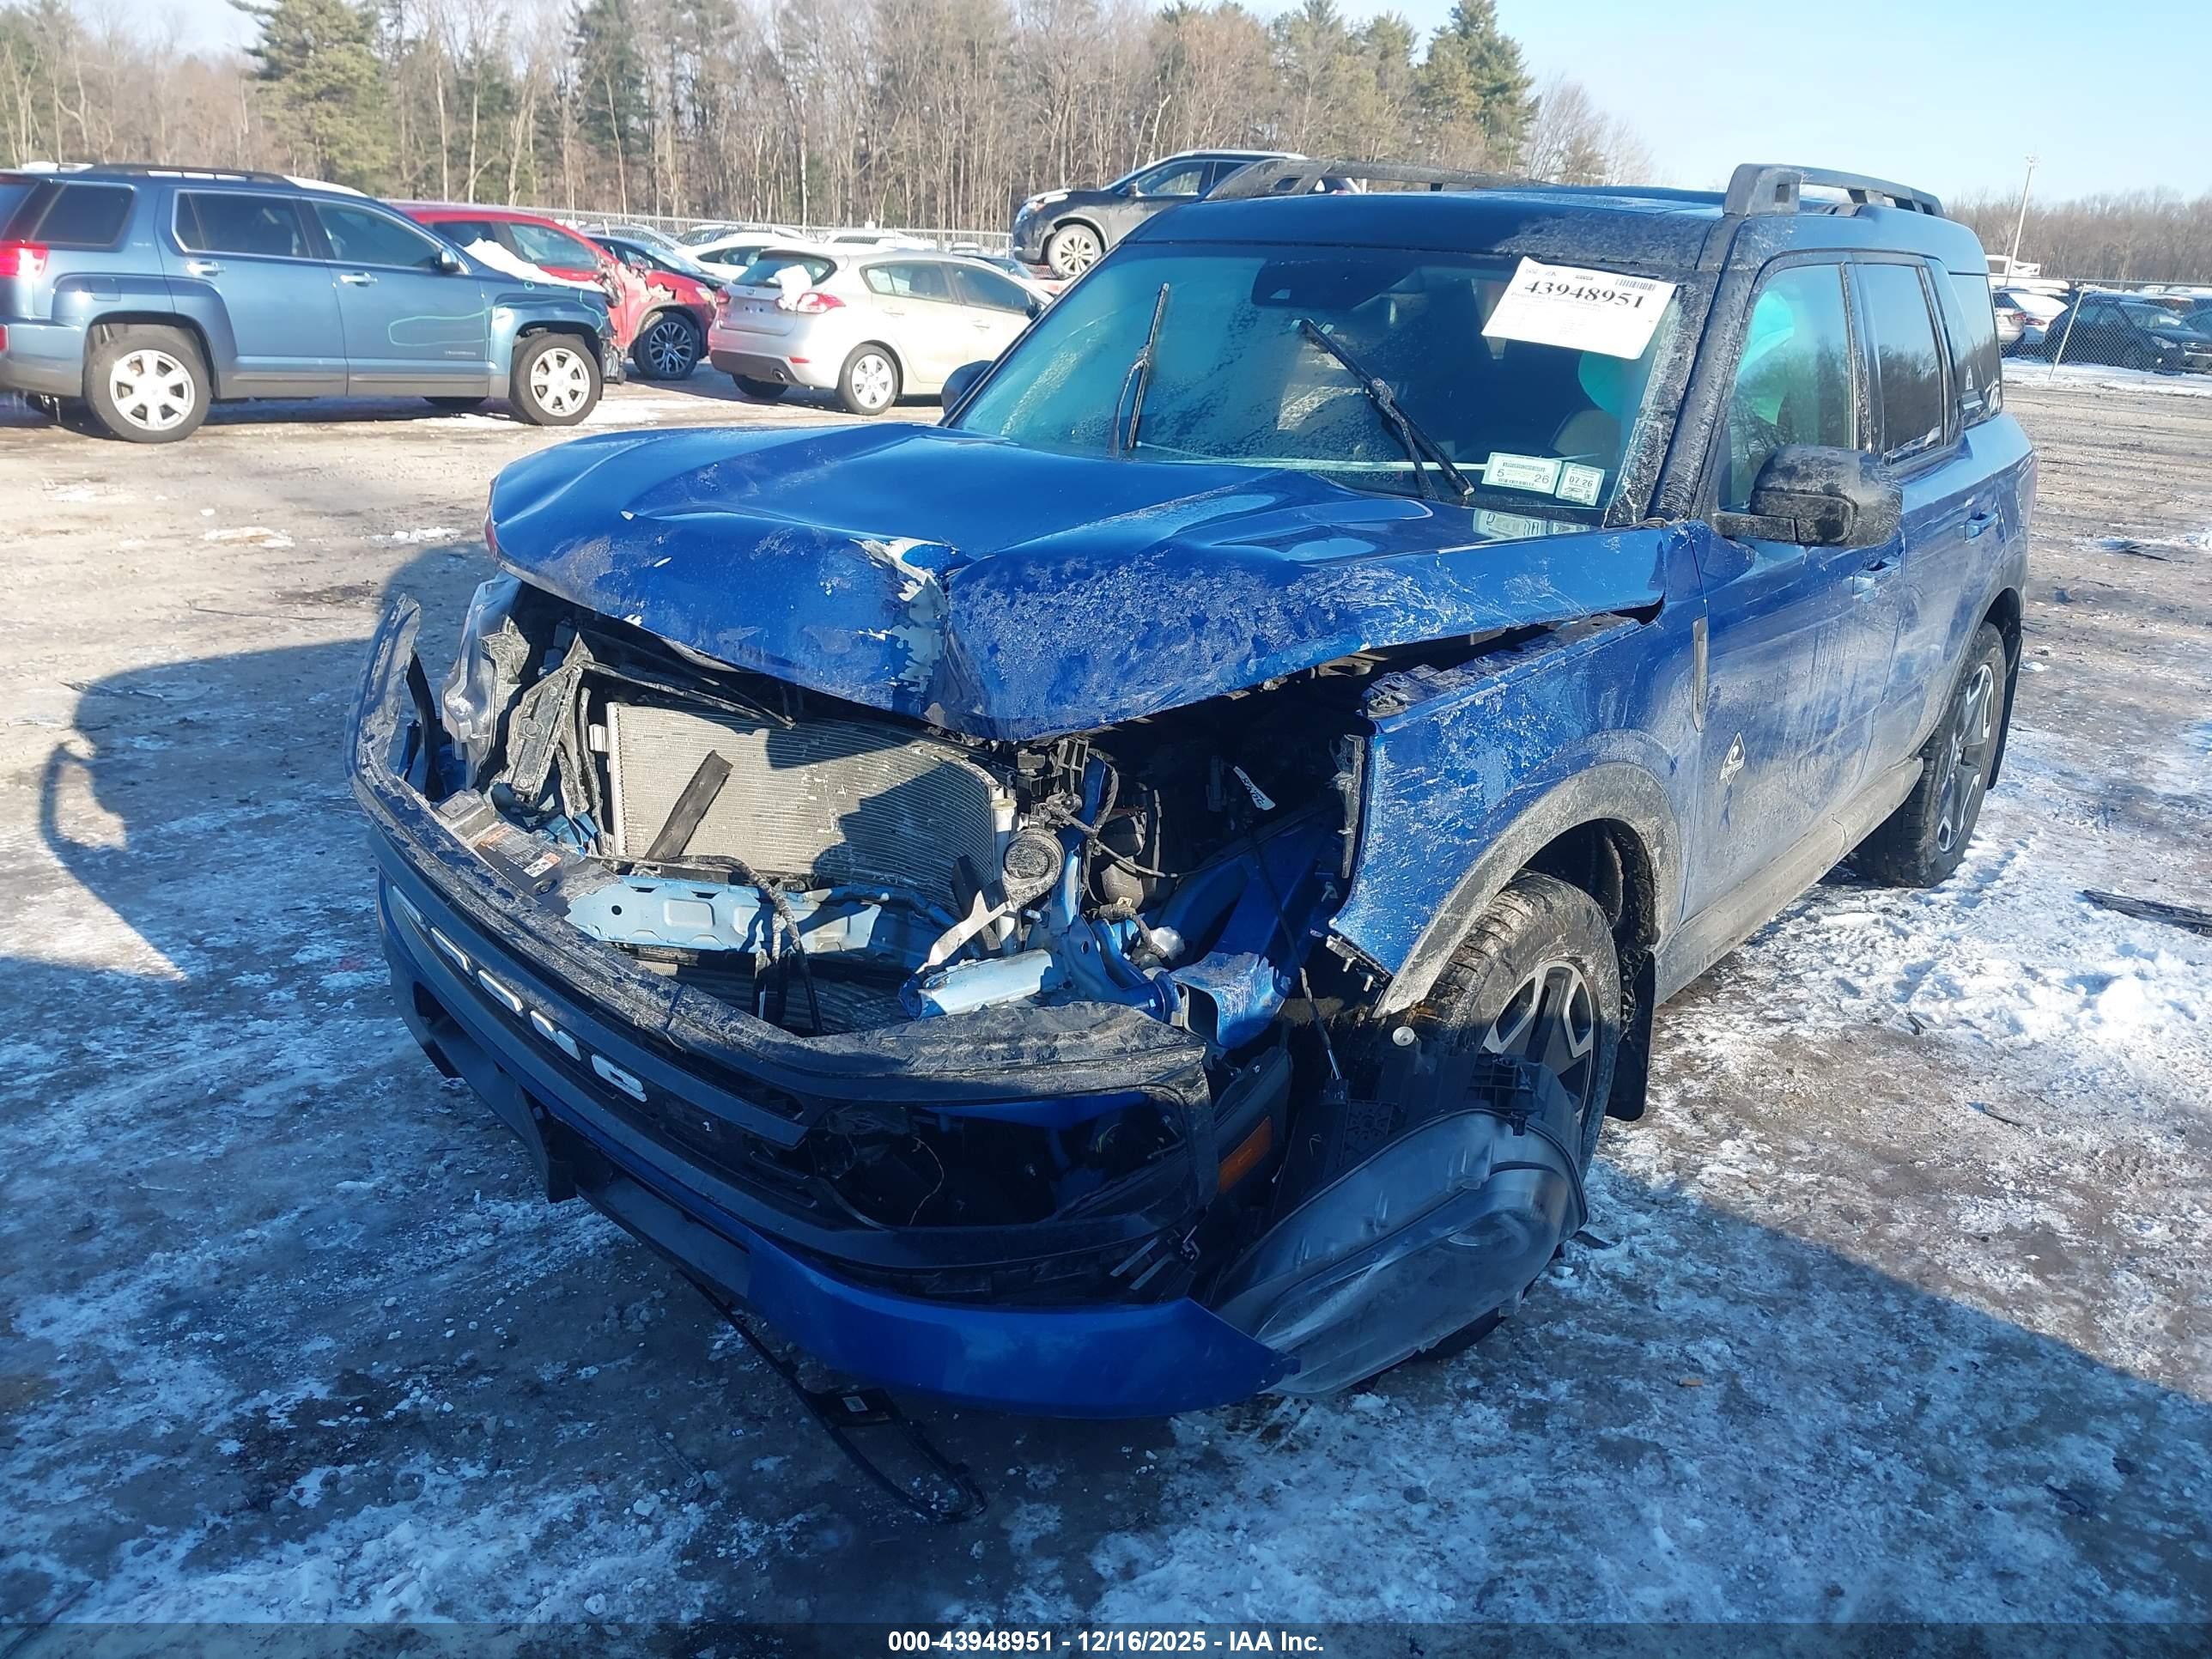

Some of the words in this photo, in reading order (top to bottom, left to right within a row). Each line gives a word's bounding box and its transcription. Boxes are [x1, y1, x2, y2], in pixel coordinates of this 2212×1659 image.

[1524, 280, 1644, 309] 43948951
[1497, 469, 1504, 477] 5
[1534, 473, 1549, 484] 26
[1569, 475, 1579, 484] 07
[1583, 478, 1593, 488] 26
